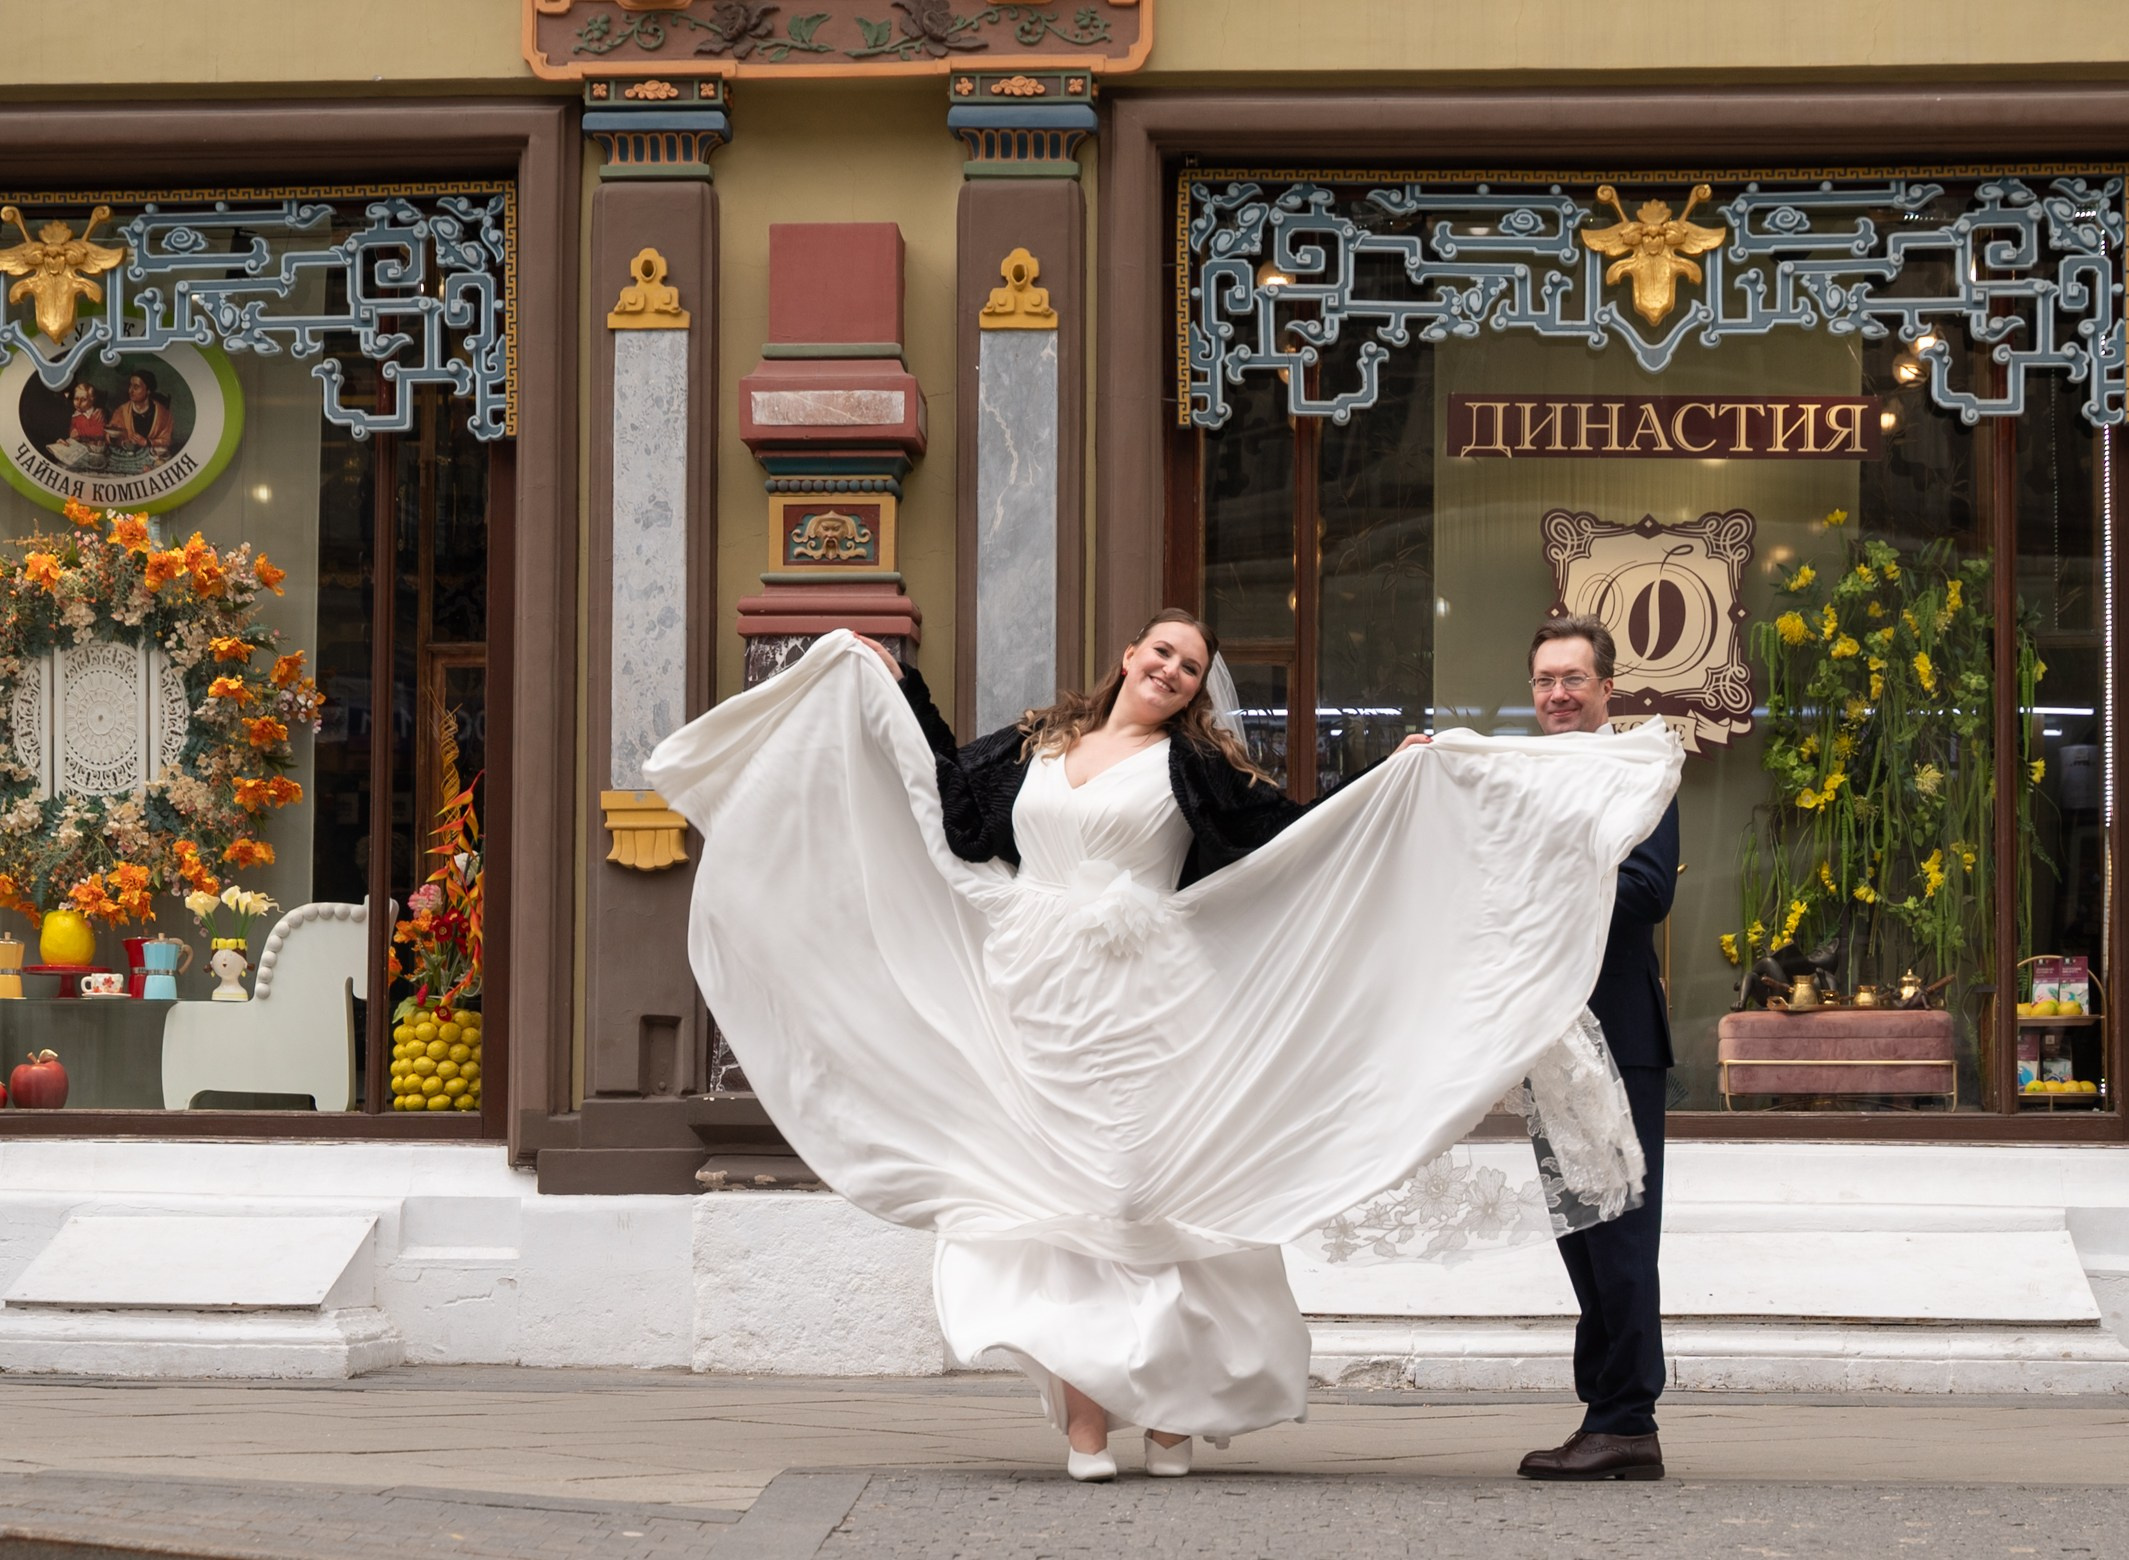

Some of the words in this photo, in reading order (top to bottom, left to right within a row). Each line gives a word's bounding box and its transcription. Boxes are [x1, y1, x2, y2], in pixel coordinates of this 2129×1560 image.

[1460, 402, 1868, 458] ДИНАСТИЯ
[15, 442, 86, 499] ЧАЙНАЯ
[92, 452, 199, 503] КОМПАНИЯ
